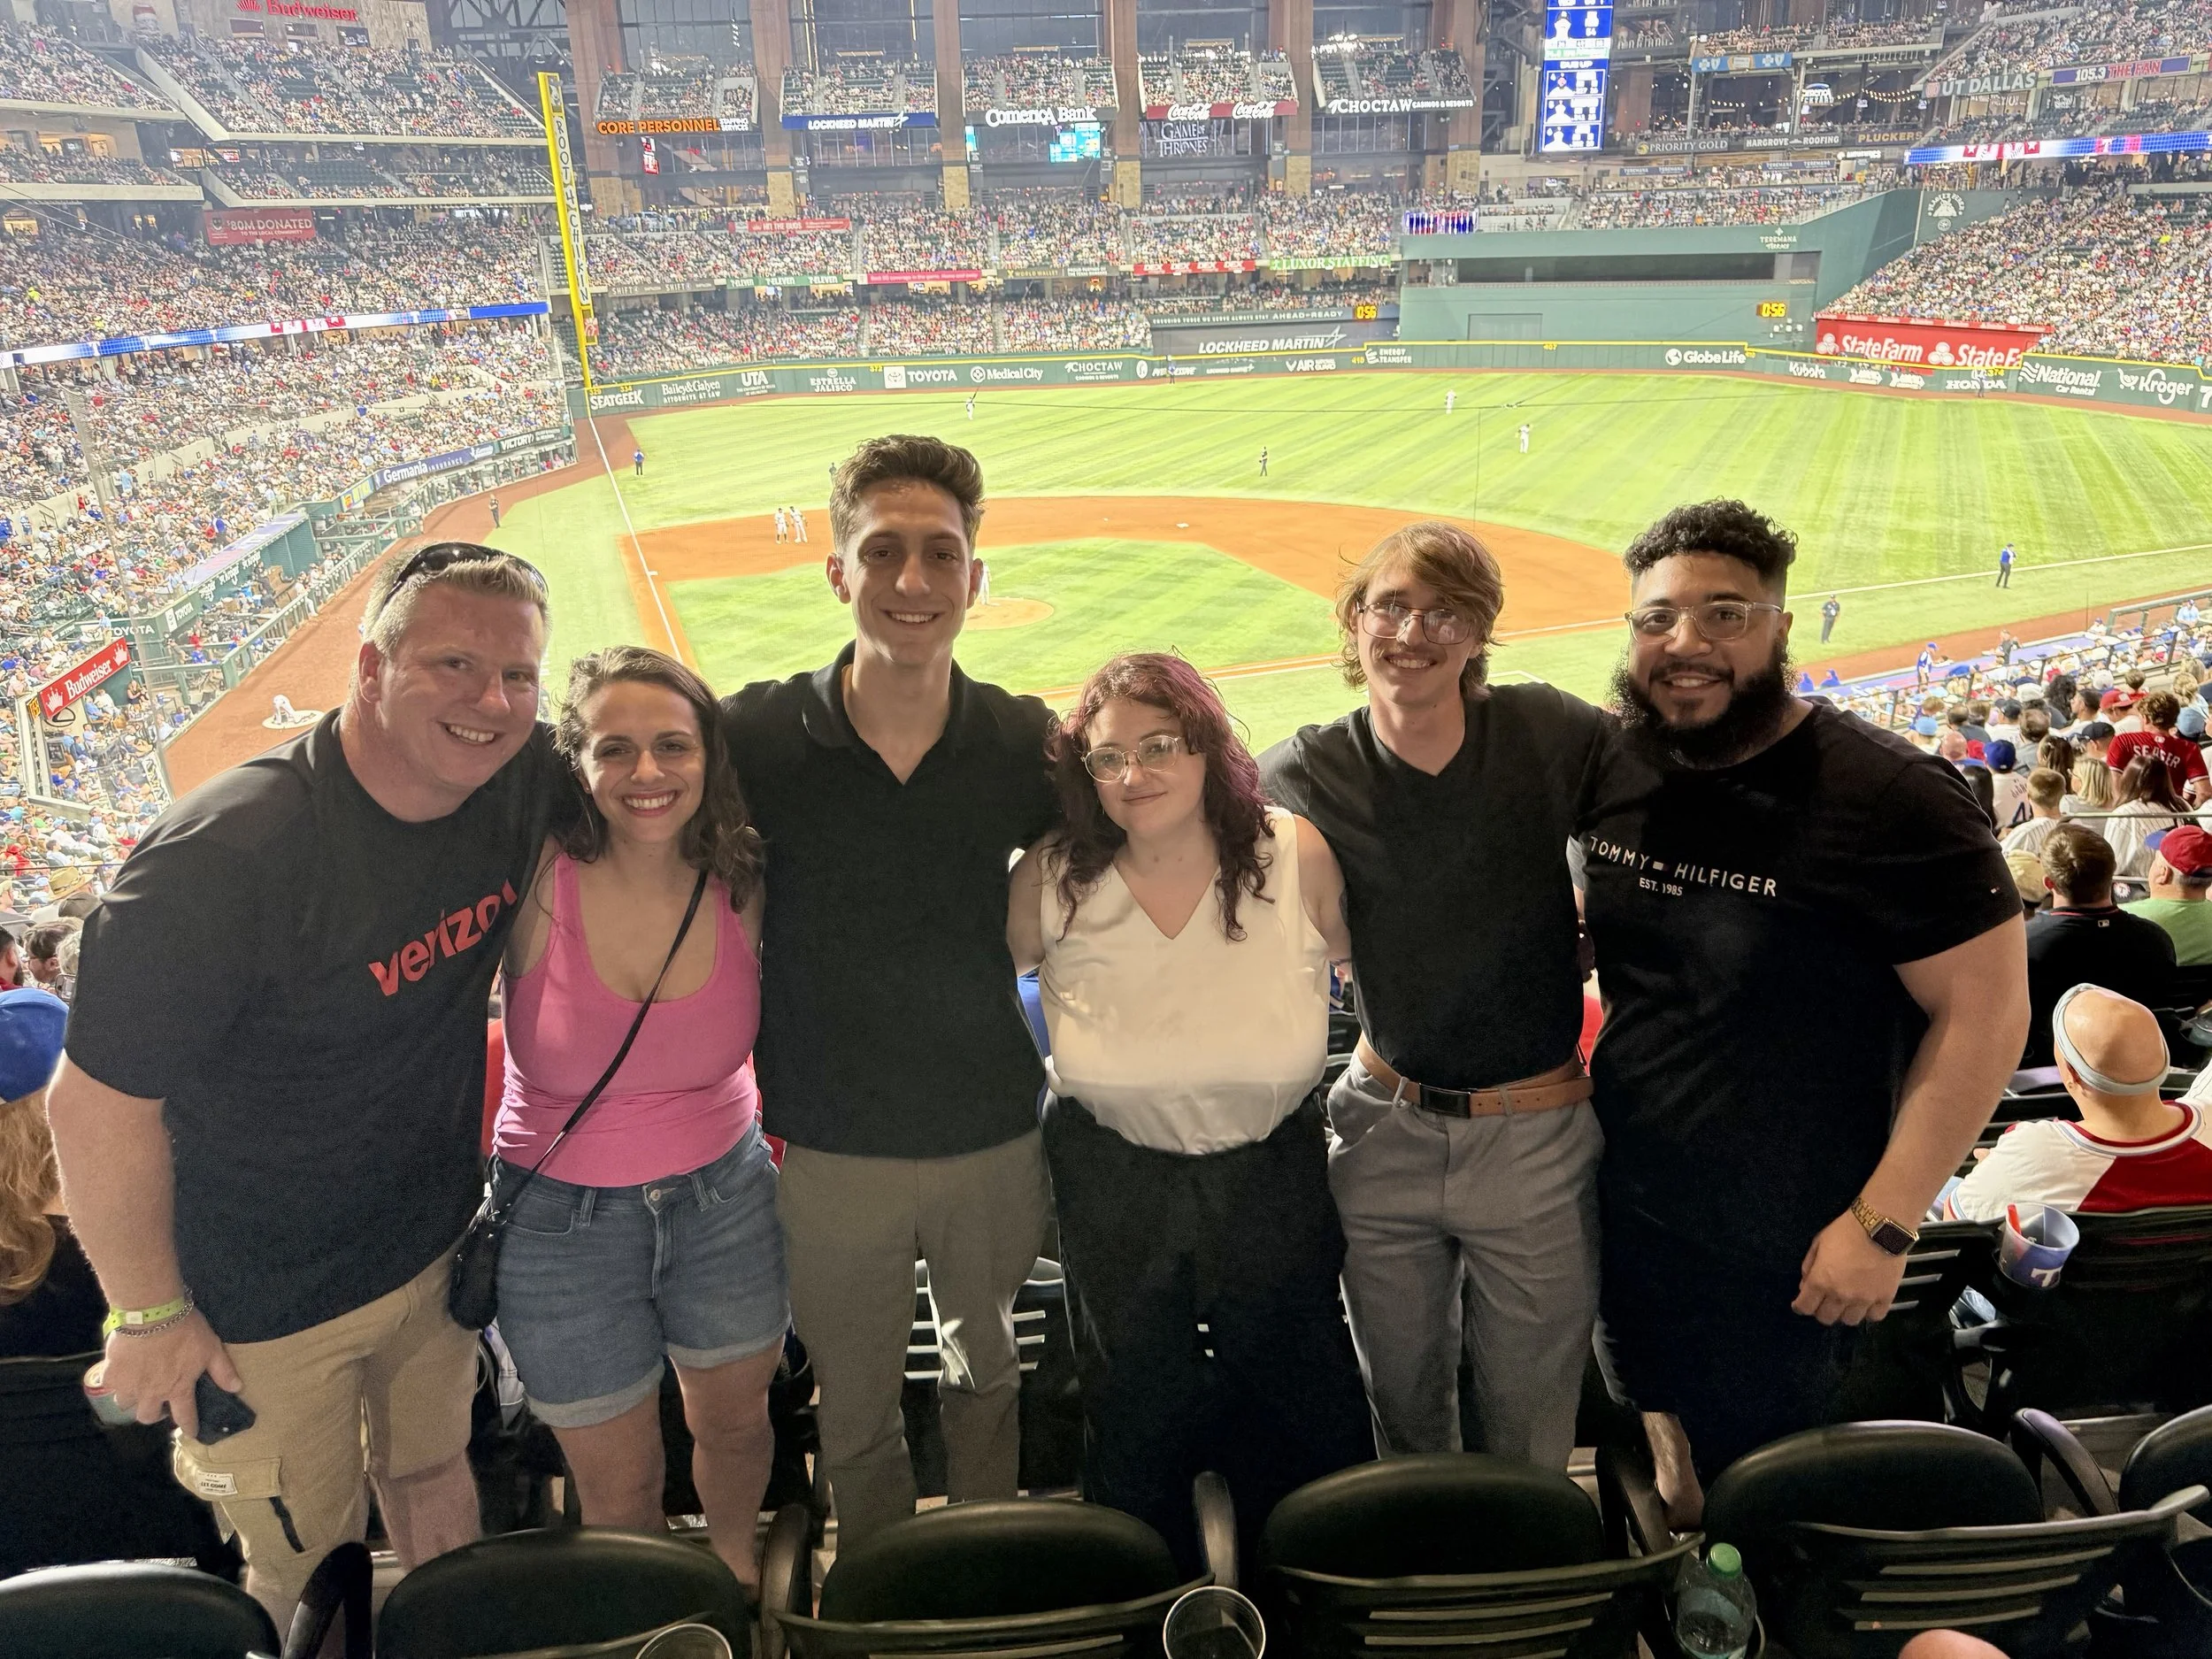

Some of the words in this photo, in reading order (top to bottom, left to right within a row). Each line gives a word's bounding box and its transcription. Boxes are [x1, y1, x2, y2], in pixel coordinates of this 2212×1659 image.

[267, 0, 358, 21] Budweiser
[2075, 67, 2106, 81] 105.3
[2108, 64, 2132, 79] THE
[2134, 60, 2162, 75] FAN
[1942, 80, 1966, 96] UT
[1969, 73, 2035, 94] DALLAS
[1057, 105, 1097, 123] Bank
[1337, 98, 1413, 113] CHOCTAW
[597, 120, 635, 134] CORE
[637, 118, 720, 134] PERSONNEL
[808, 119, 856, 130] LOCKHEED
[858, 118, 894, 128] MARTIN
[1162, 122, 1198, 140] GAME
[1746, 138, 1789, 148] HARGROVE
[1802, 135, 1839, 145] ROOFING
[1858, 132, 1923, 142] PLUCKERS
[555, 119, 572, 182] ROOT
[1158, 138, 1209, 157] THRONES
[1650, 142, 1696, 152] PRIORITY
[1698, 140, 1728, 150] GOLD
[227, 219, 255, 231] $80M
[257, 219, 312, 230] DONATED
[1282, 257, 1326, 269] LUXOR
[1329, 254, 1388, 267] STAFFING
[1198, 339, 1270, 354] LOCKHEED
[1271, 337, 1325, 351] MARTIN
[1296, 359, 1315, 371] AIR
[1683, 349, 1721, 364] Globe
[1722, 349, 1747, 364] Life
[987, 366, 1024, 380] Medical
[1024, 367, 1044, 381] City
[1071, 361, 1123, 373] CHOCTAW
[1789, 361, 1826, 380] Kubota
[741, 370, 769, 387] UTA
[810, 376, 857, 386] ESTRELLA
[907, 369, 958, 383] TOYOTA
[2055, 384, 2070, 393] Car
[2070, 386, 2096, 396] Rental
[2138, 368, 2194, 404] Kroger
[589, 389, 645, 410] SEATGEEK
[664, 395, 697, 403] ATTORNEYS
[500, 434, 531, 451] VICTORY
[383, 460, 429, 482] Germania
[174, 603, 195, 621] TOYOTA
[65, 659, 113, 700] Budweiser
[1590, 835, 1650, 871] TOMMY
[1674, 863, 1777, 897] HILFIGER
[1639, 877, 1658, 892] EST.
[1662, 882, 1683, 896] 1985
